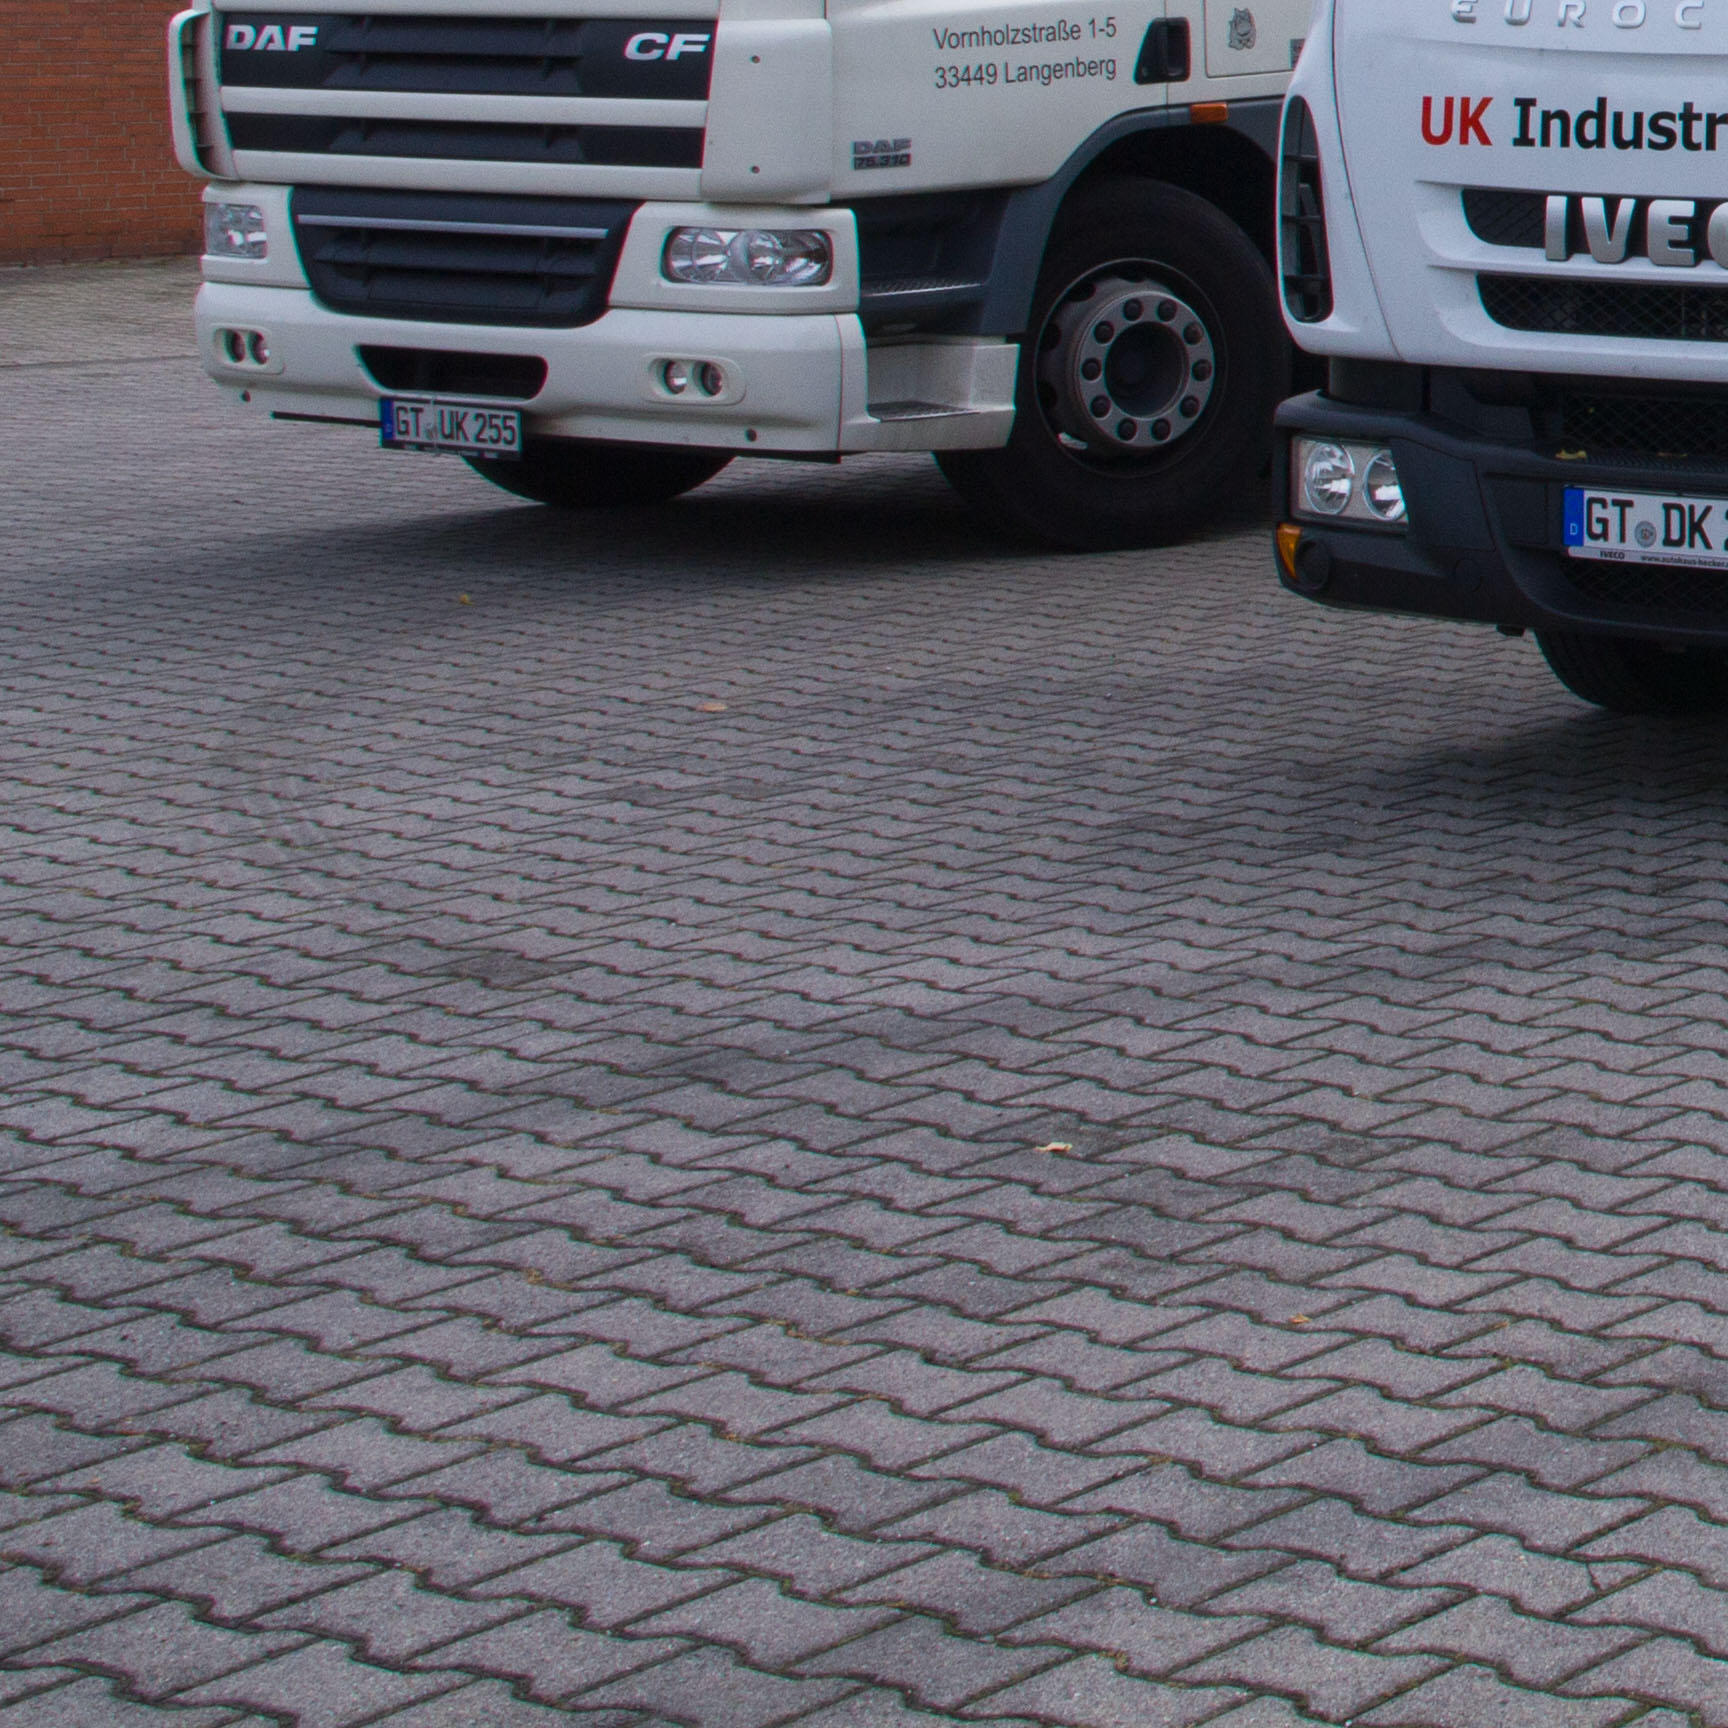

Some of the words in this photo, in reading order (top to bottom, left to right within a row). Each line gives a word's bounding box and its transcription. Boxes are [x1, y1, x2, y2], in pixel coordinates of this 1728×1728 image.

[225, 24, 318, 52] DAF
[623, 32, 711, 61] CF
[933, 19, 1081, 50] Vornholzstraße
[1089, 16, 1117, 38] 1-5
[935, 62, 997, 89] 33449
[1004, 56, 1117, 86] Langenberg
[1420, 95, 1494, 146] UK
[852, 137, 912, 154] DAF
[396, 406, 424, 438] GT
[440, 409, 470, 442] UK
[475, 412, 516, 446] 255
[1586, 496, 1634, 544] GT
[1661, 502, 1713, 550] DK
[1600, 550, 1625, 560] IVECO
